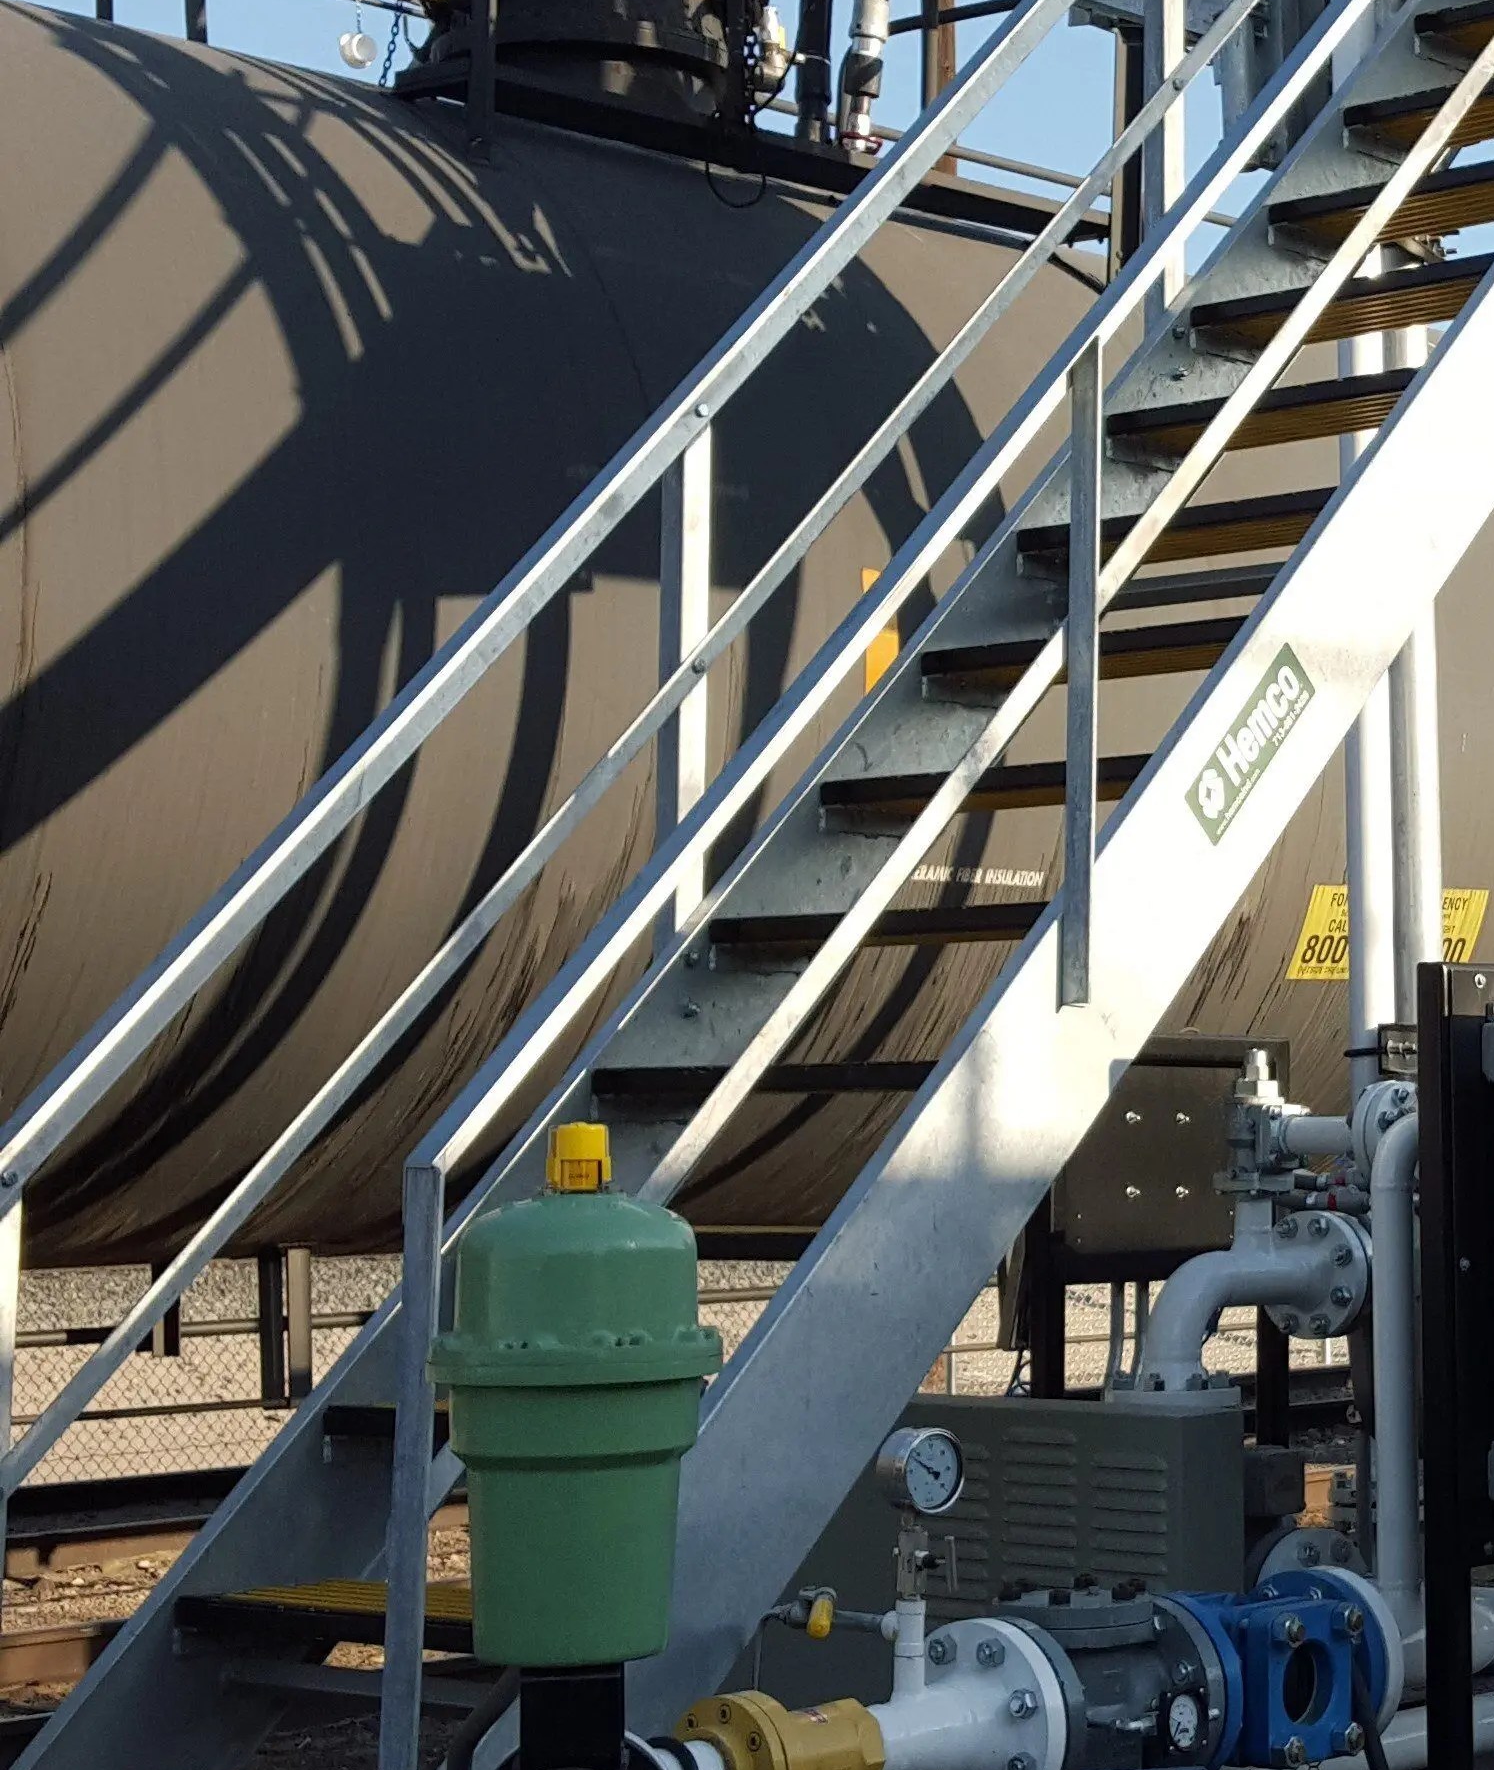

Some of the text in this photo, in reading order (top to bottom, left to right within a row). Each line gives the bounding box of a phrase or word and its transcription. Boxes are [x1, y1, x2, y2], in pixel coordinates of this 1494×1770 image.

[1216, 665, 1300, 787] Hemco
[911, 864, 953, 881] ERAMIC
[985, 868, 1045, 887] INSULATION
[1442, 896, 1469, 911] ENCY
